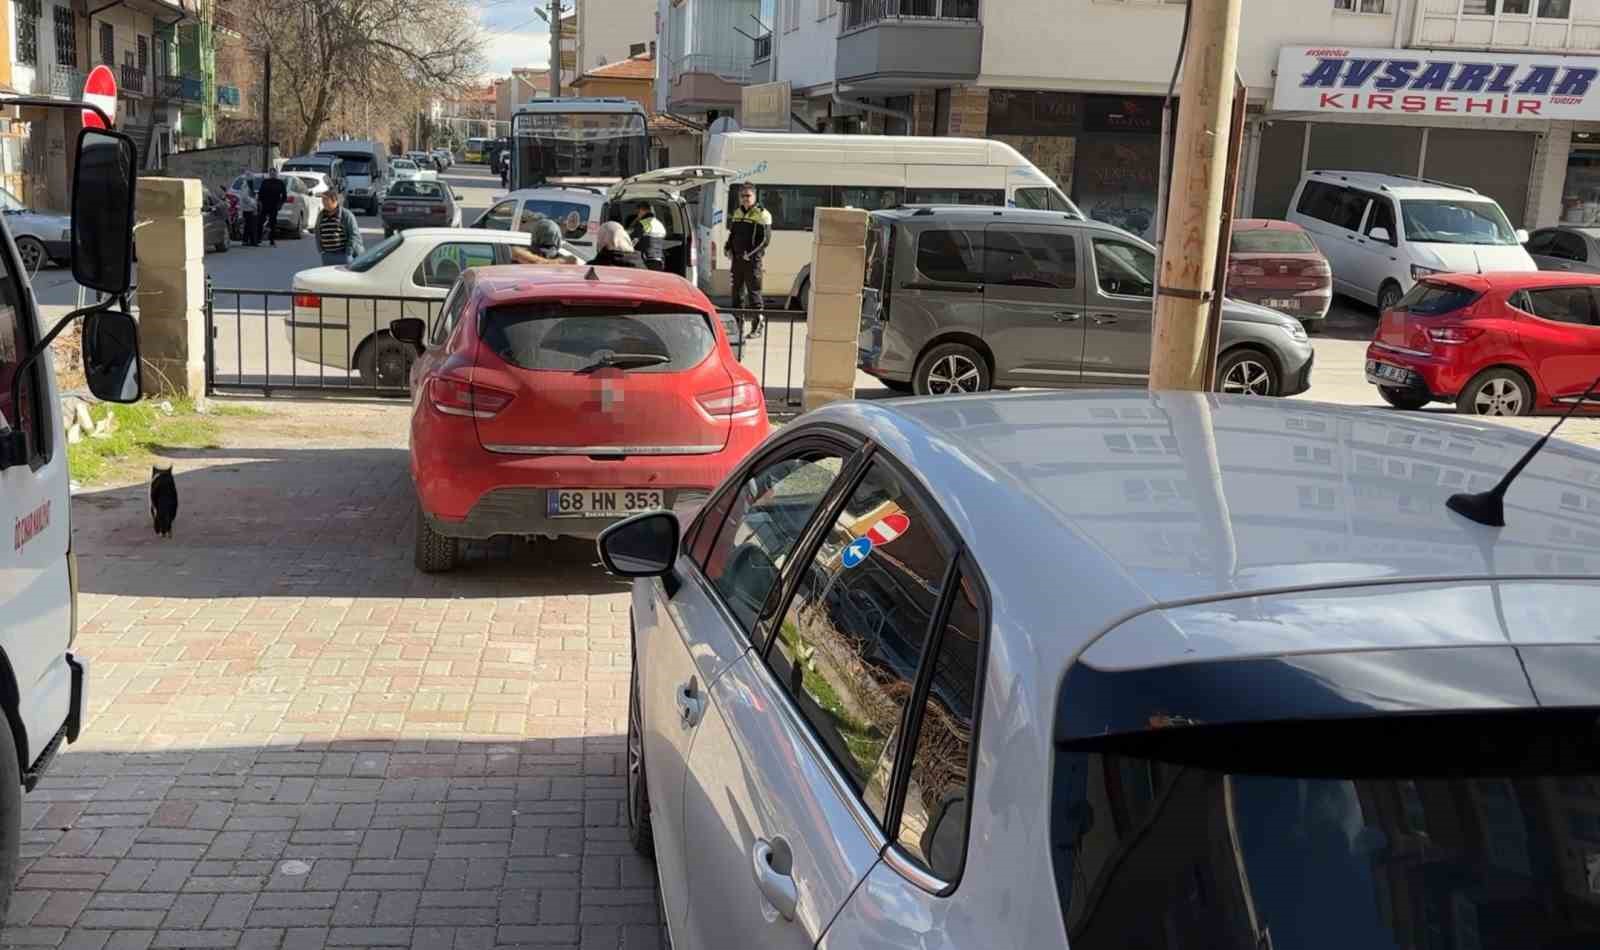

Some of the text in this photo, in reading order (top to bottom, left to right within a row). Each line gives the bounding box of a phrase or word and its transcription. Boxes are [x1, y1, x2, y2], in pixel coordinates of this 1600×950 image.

[1300, 58, 1599, 97] AVŞARLAR
[559, 491, 661, 511] 68 HN 353
